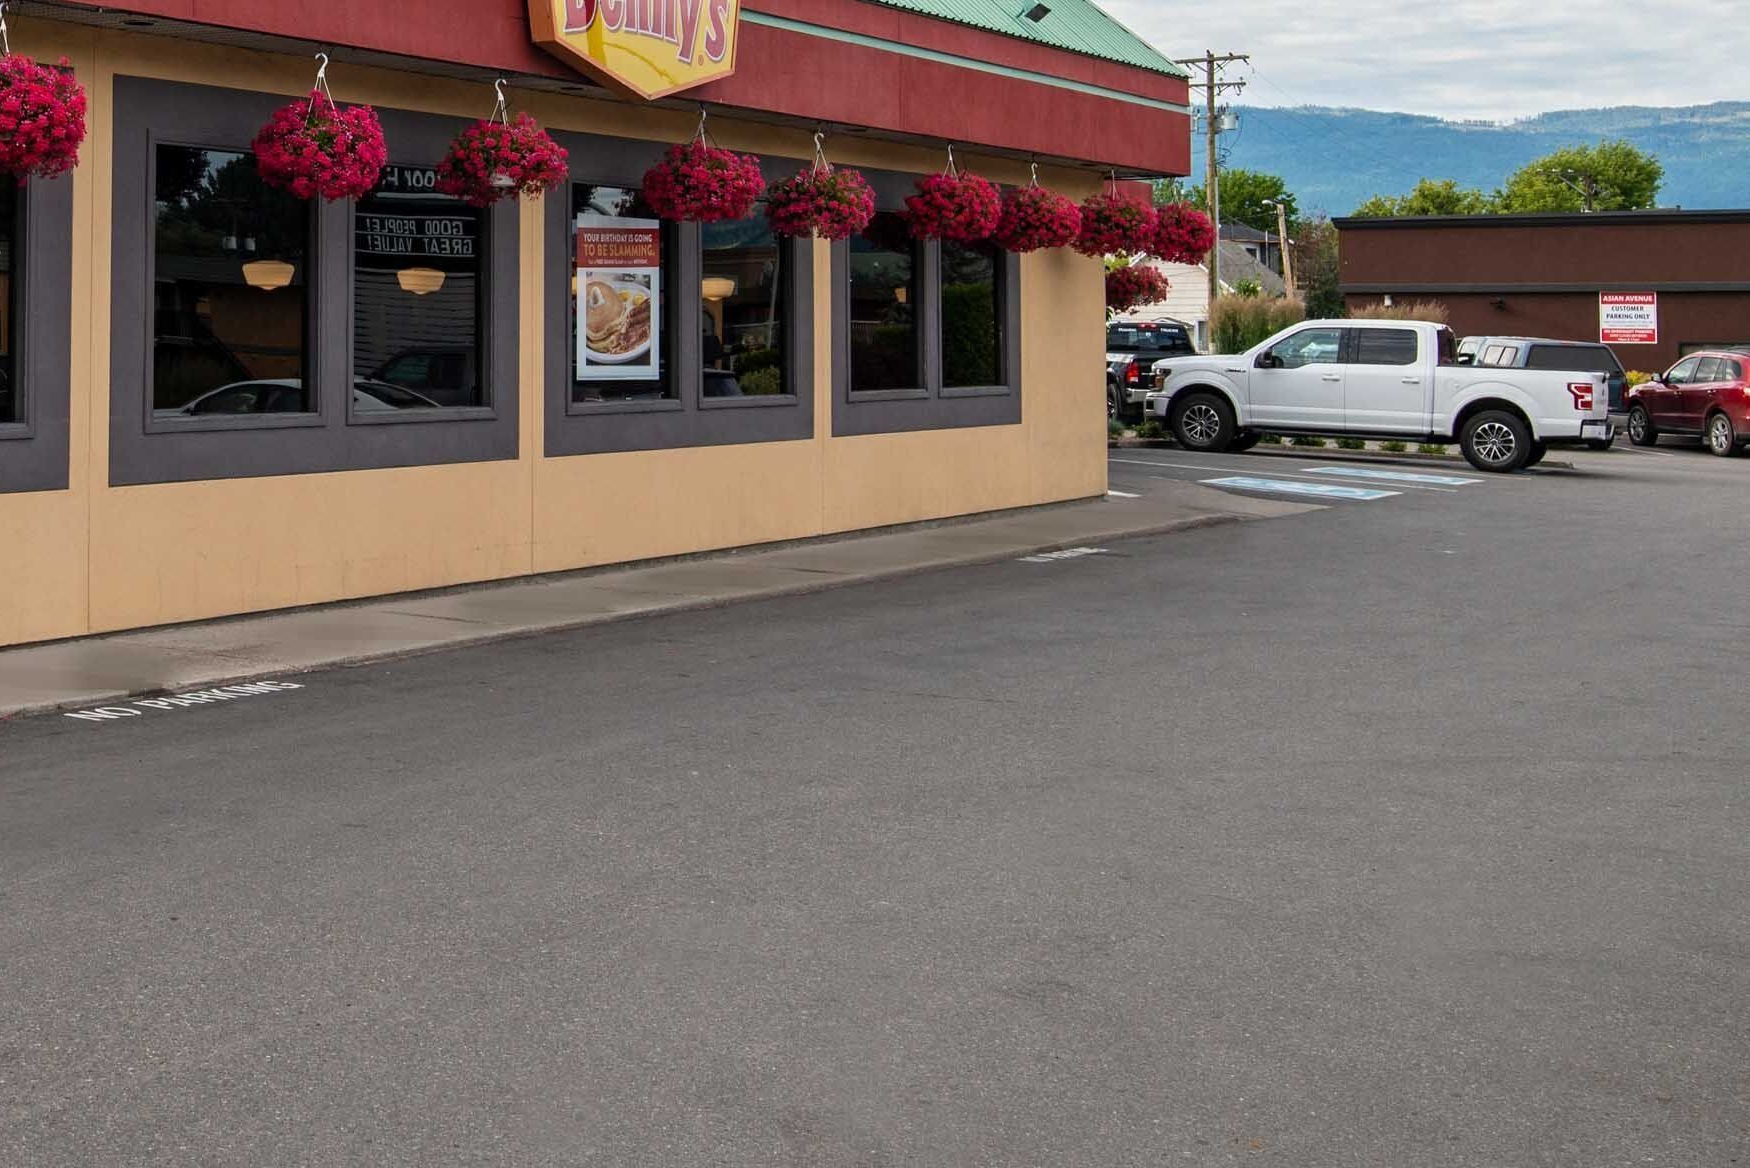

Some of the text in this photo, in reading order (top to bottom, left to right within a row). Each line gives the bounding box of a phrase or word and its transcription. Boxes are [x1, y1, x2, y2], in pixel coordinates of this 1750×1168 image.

[583, 233, 600, 242] YOUR
[600, 233, 628, 242] BIRTHDAY
[634, 234, 653, 242] GOING
[584, 244, 656, 257] TO BE SLAMMING.
[64, 681, 306, 721] NO PARKING
